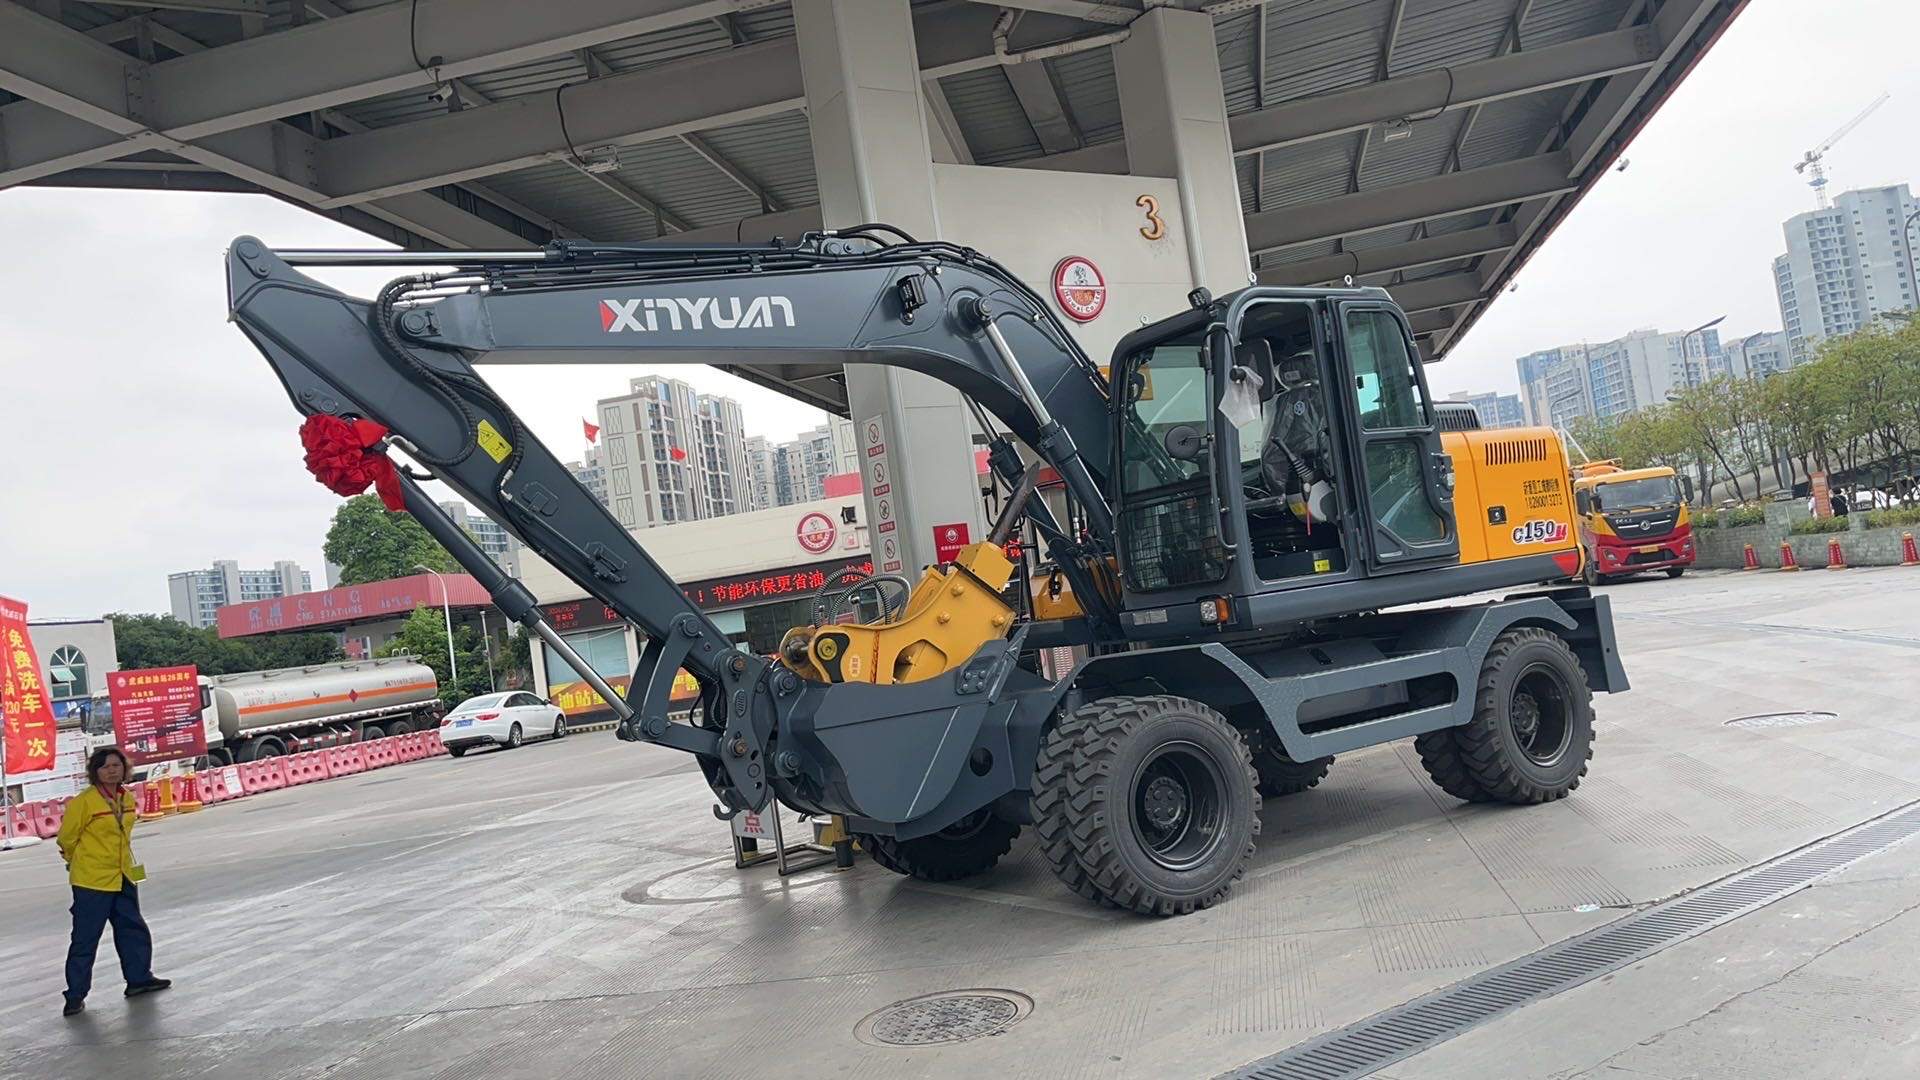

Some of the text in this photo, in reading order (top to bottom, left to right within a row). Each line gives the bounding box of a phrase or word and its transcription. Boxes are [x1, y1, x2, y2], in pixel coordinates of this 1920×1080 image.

[1135, 194, 1166, 241] 3
[711, 569, 825, 603] 节能环保更省油
[296, 611, 314, 622] CNG
[9, 628, 49, 758] 免费洗车一次
